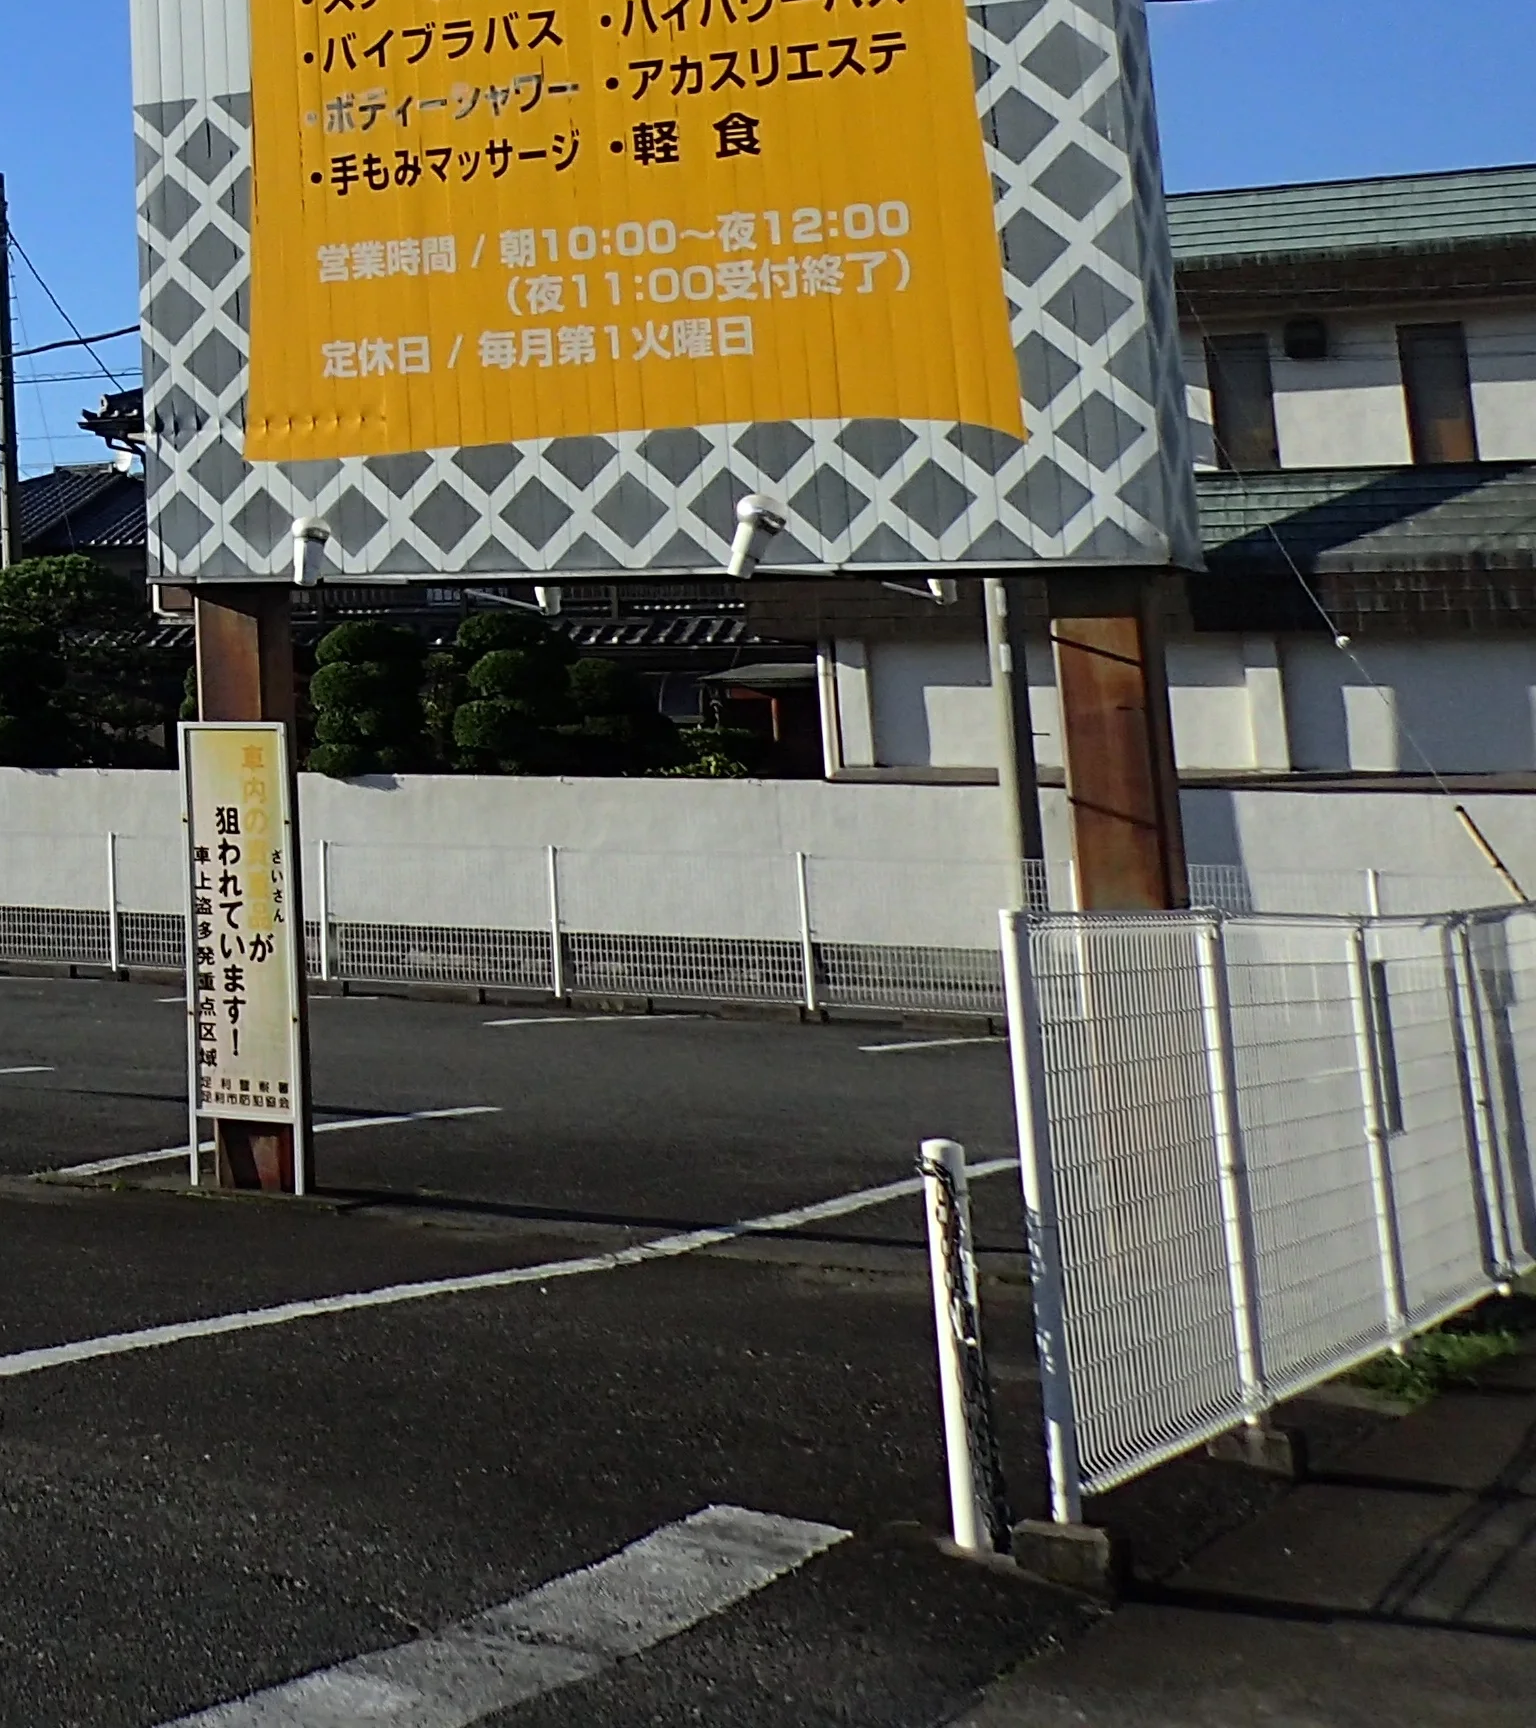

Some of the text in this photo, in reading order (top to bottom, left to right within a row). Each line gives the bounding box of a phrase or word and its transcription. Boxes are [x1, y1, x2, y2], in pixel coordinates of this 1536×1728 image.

[215, 806, 247, 1057] 狙われています!
